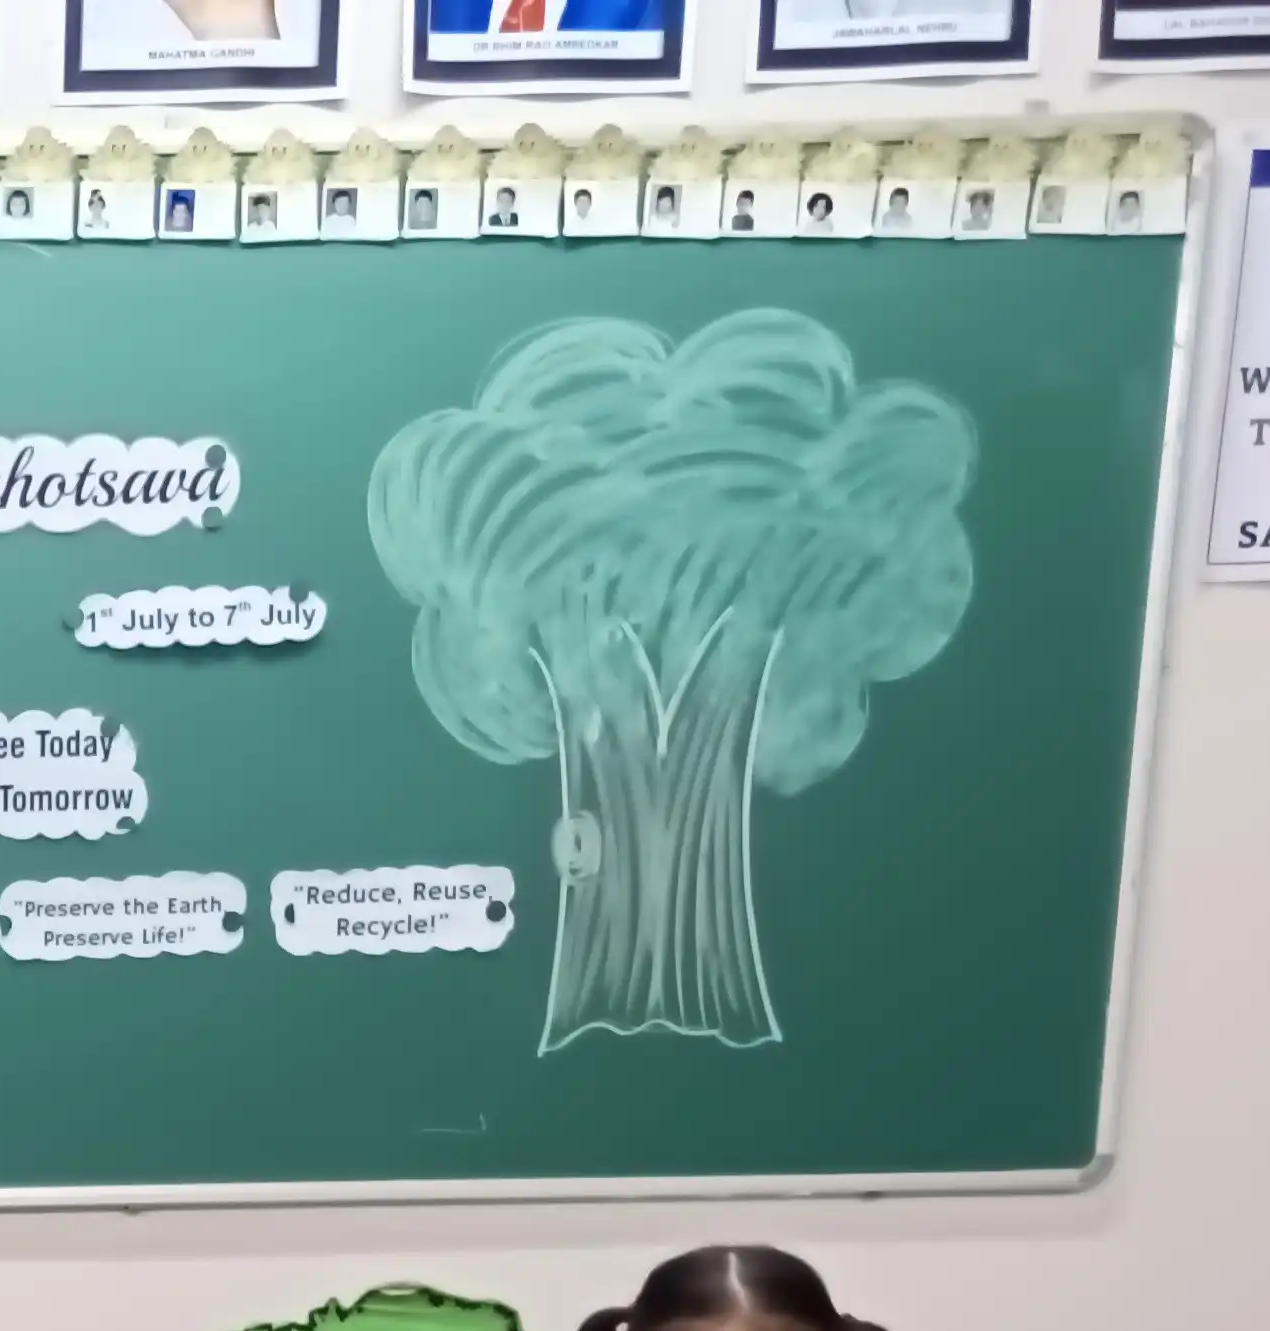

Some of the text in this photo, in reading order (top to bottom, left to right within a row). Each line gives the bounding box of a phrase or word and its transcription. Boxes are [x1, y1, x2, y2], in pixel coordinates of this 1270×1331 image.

[148, 48, 256, 60] MAHATMA GANDHI
[122, 608, 179, 636] July
[188, 607, 215, 629] to
[260, 602, 317, 631] July
[35, 729, 115, 763] Today
[413, 880, 494, 903] Reuse,
[123, 897, 160, 916] the
[43, 928, 134, 948] Preserve
